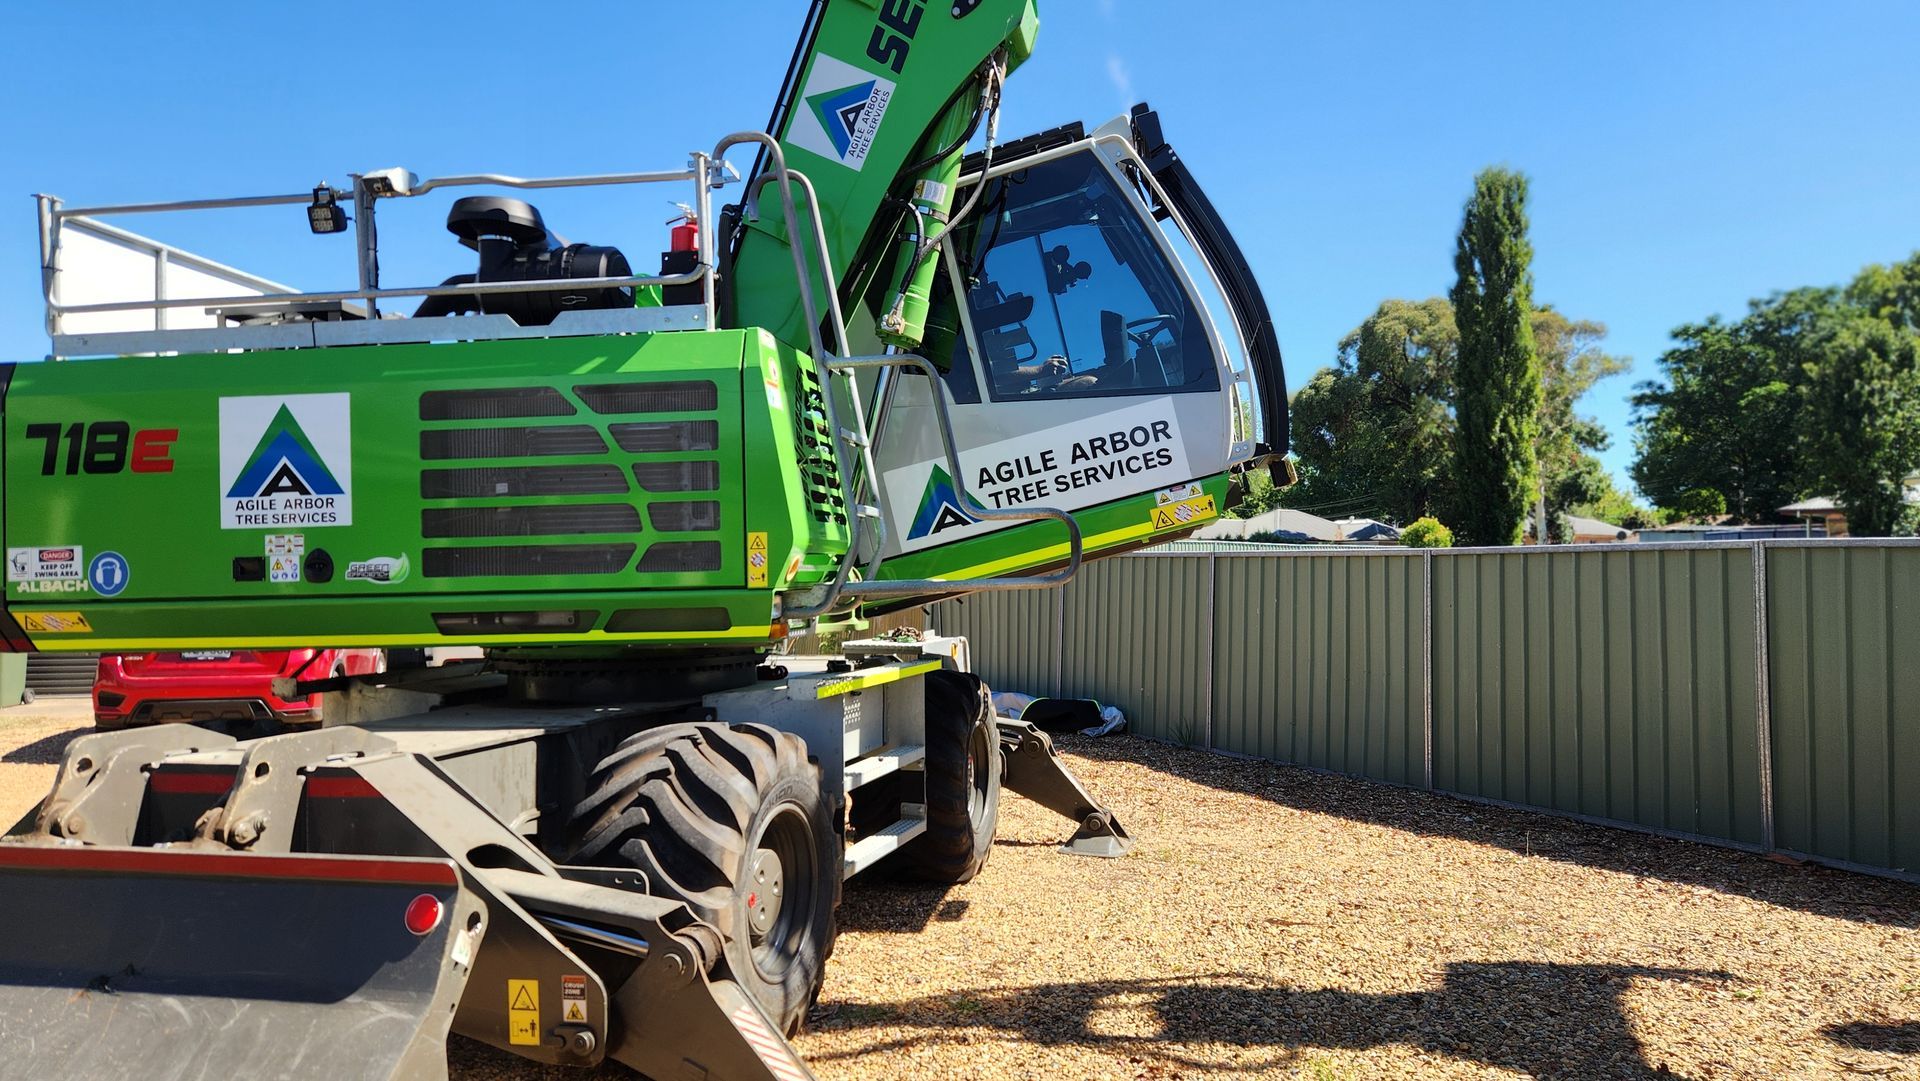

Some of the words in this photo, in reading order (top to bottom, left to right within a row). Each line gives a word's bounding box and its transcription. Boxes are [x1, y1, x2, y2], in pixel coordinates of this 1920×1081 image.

[866, 0, 928, 75] SE
[848, 126, 865, 157] AGILE
[861, 88, 882, 125] ARBOR
[856, 136, 871, 160] TREE
[866, 90, 890, 136] SERVICES
[978, 450, 1058, 489] AGILE
[1070, 420, 1173, 465] ARBOR
[988, 474, 1050, 509] TREE
[1054, 448, 1173, 493] SERVICES
[235, 499, 277, 511] AGILE
[284, 497, 335, 510] ARBOR
[235, 514, 268, 525] TREE
[272, 512, 337, 524] SERVICES
[43, 550, 70, 560] DANGER
[16, 579, 88, 593] ALBACH
